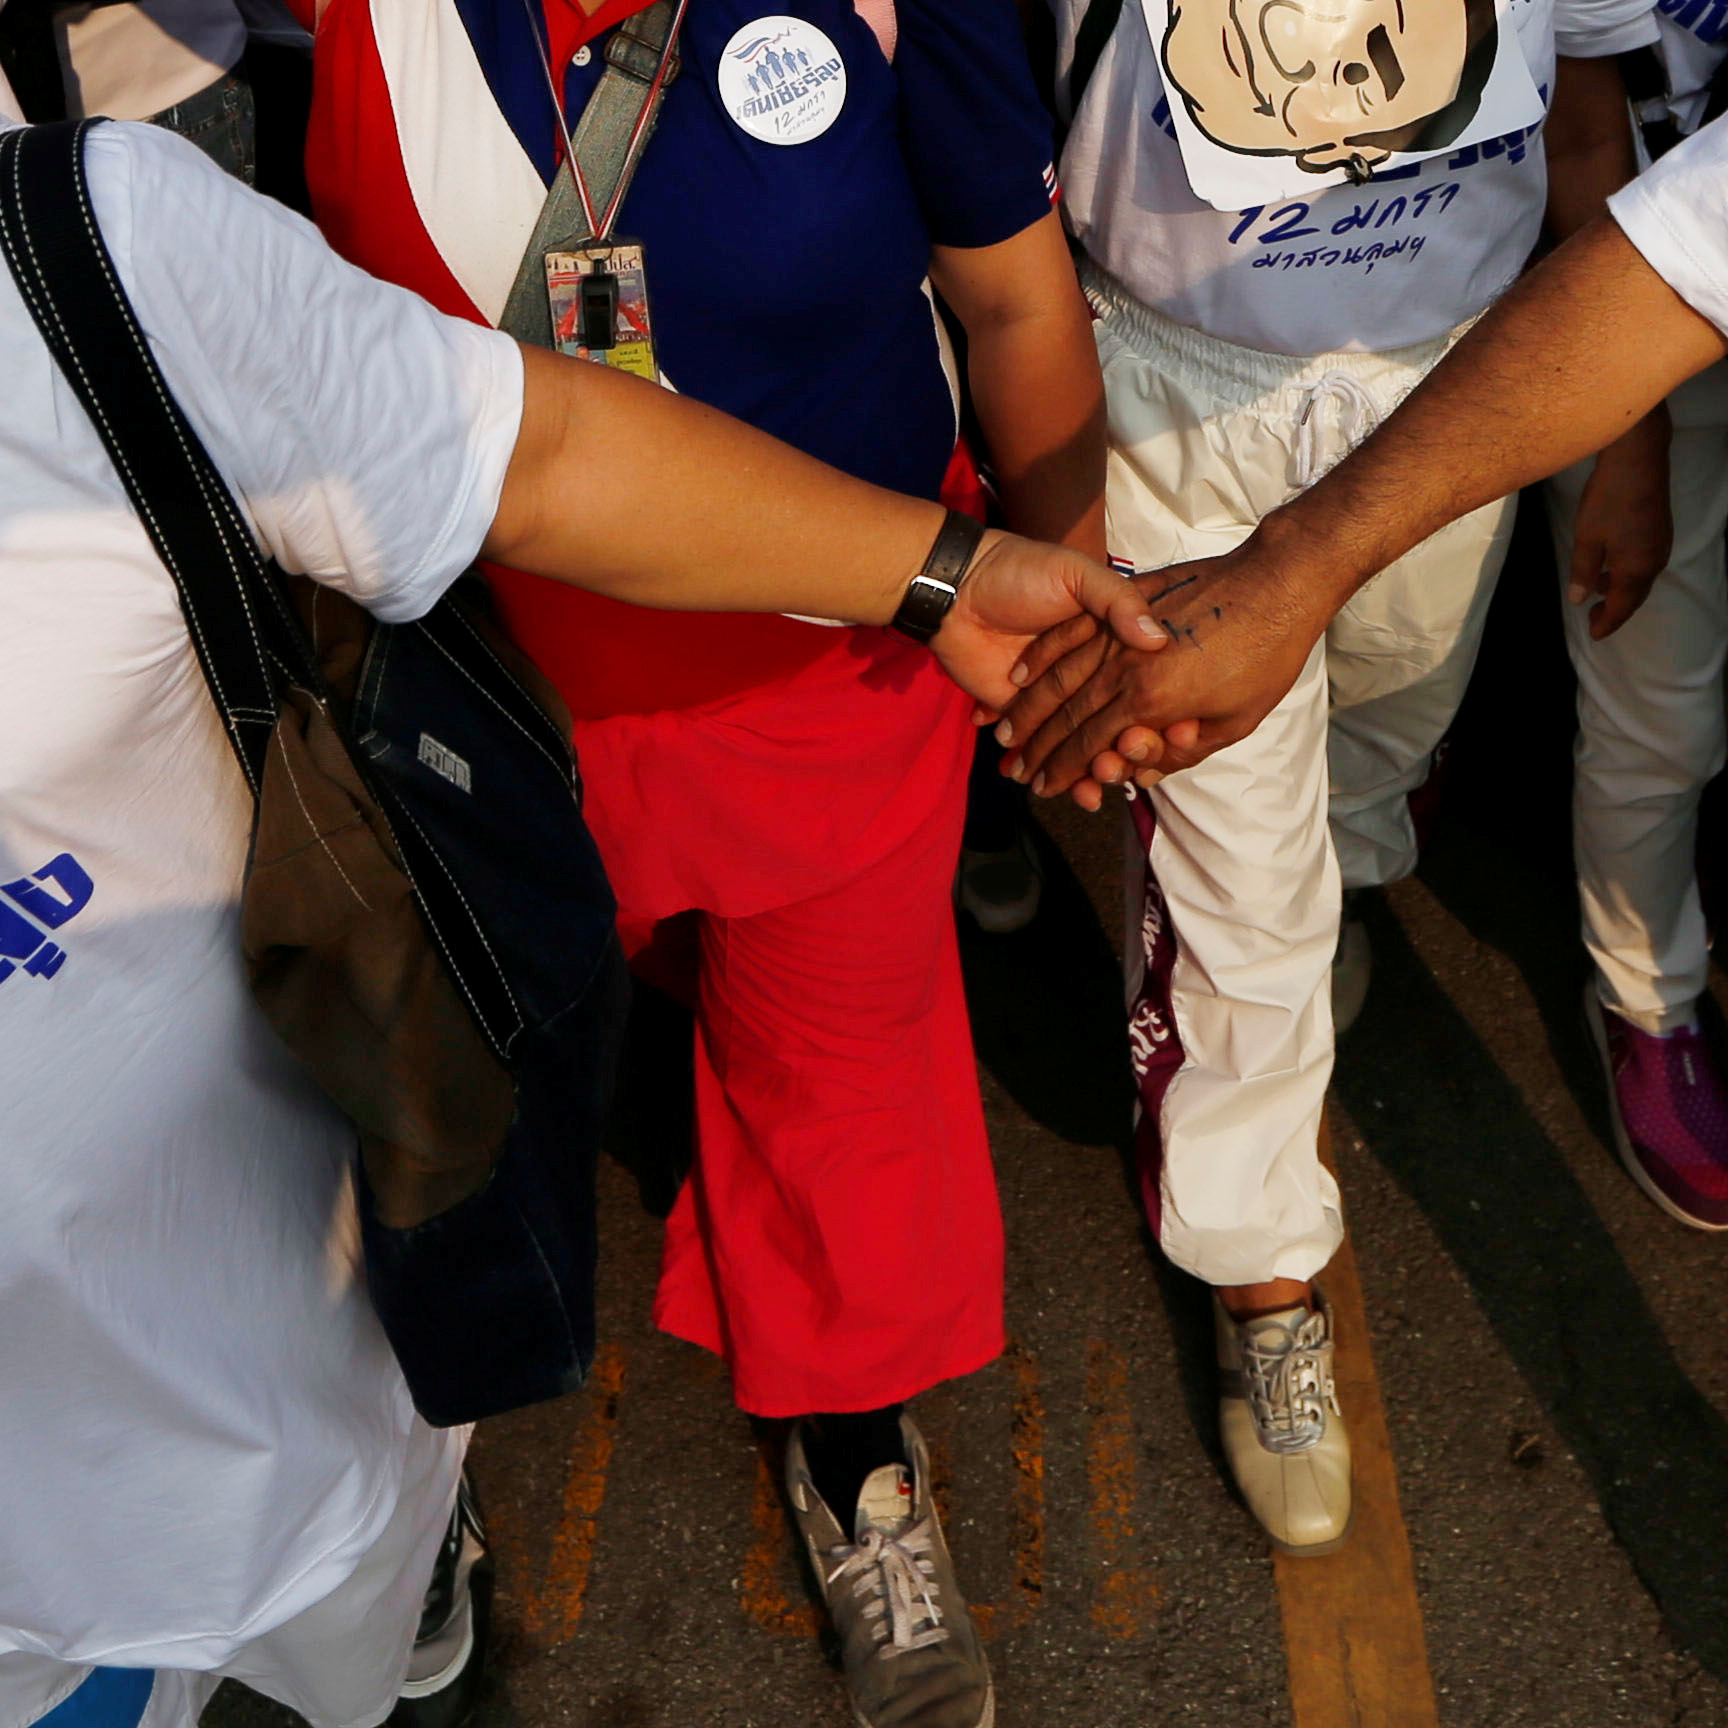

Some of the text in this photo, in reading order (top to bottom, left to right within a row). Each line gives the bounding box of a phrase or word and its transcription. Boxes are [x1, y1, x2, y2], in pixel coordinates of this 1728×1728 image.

[736, 57, 842, 121] เดินเชียร์ลุง
[774, 112, 794, 135] 12
[1227, 183, 1460, 246] 12 มกรา
